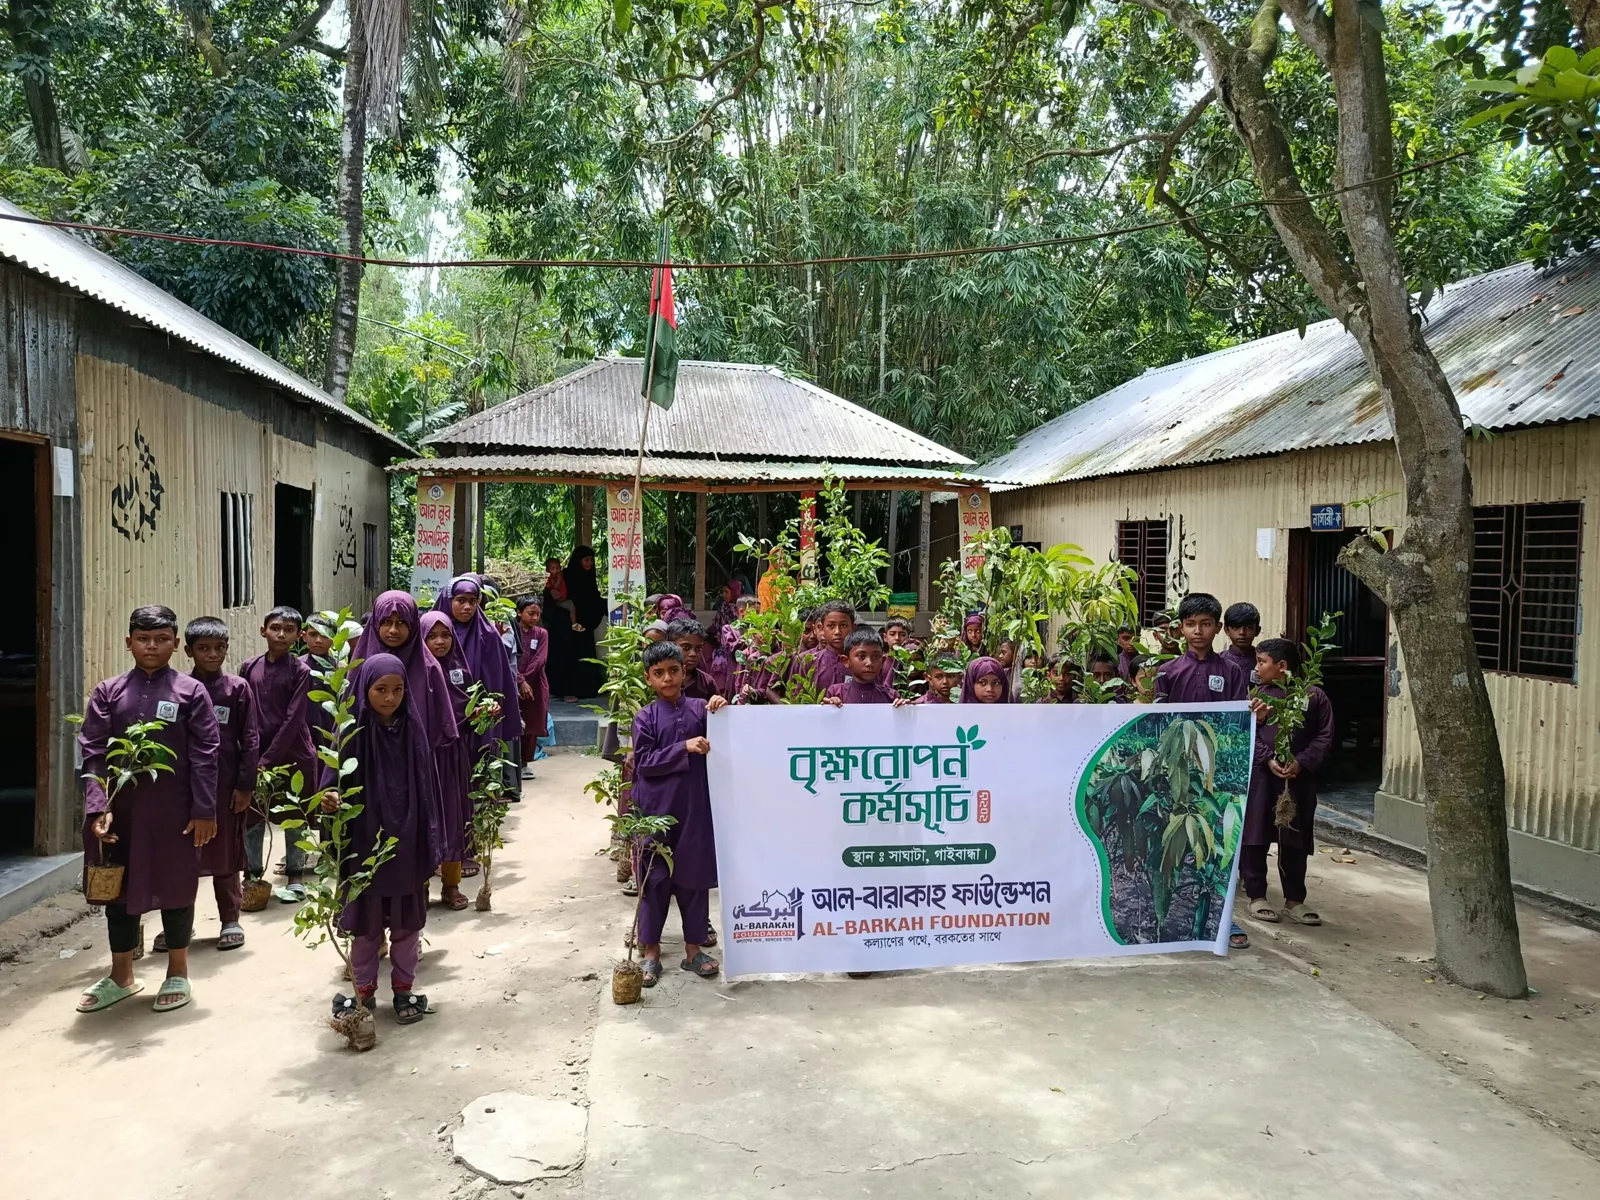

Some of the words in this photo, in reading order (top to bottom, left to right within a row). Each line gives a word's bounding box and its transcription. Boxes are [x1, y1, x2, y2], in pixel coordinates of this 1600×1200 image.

[419, 503, 436, 520] আন
[438, 504, 451, 526] নূর
[611, 507, 626, 523] আন
[417, 524, 450, 548] ইসলামিক
[416, 548, 449, 571] একাডেমি
[787, 745, 970, 794] বৃক্ষরোপন
[840, 783, 971, 834] কর্মসূচি
[851, 849, 875, 866] স্থান
[811, 884, 946, 912] আল-বারাকাহ
[952, 874, 1050, 908] ফাউন্ডেশন
[734, 921, 795, 931] AL-BARAKAH
[812, 916, 924, 937] AL-BARKAH
[930, 912, 1050, 930] FOUNDATION
[863, 936, 904, 949] কল্যাণের
[934, 932, 975, 946] বরকতের
[979, 931, 1002, 943] সাথে
